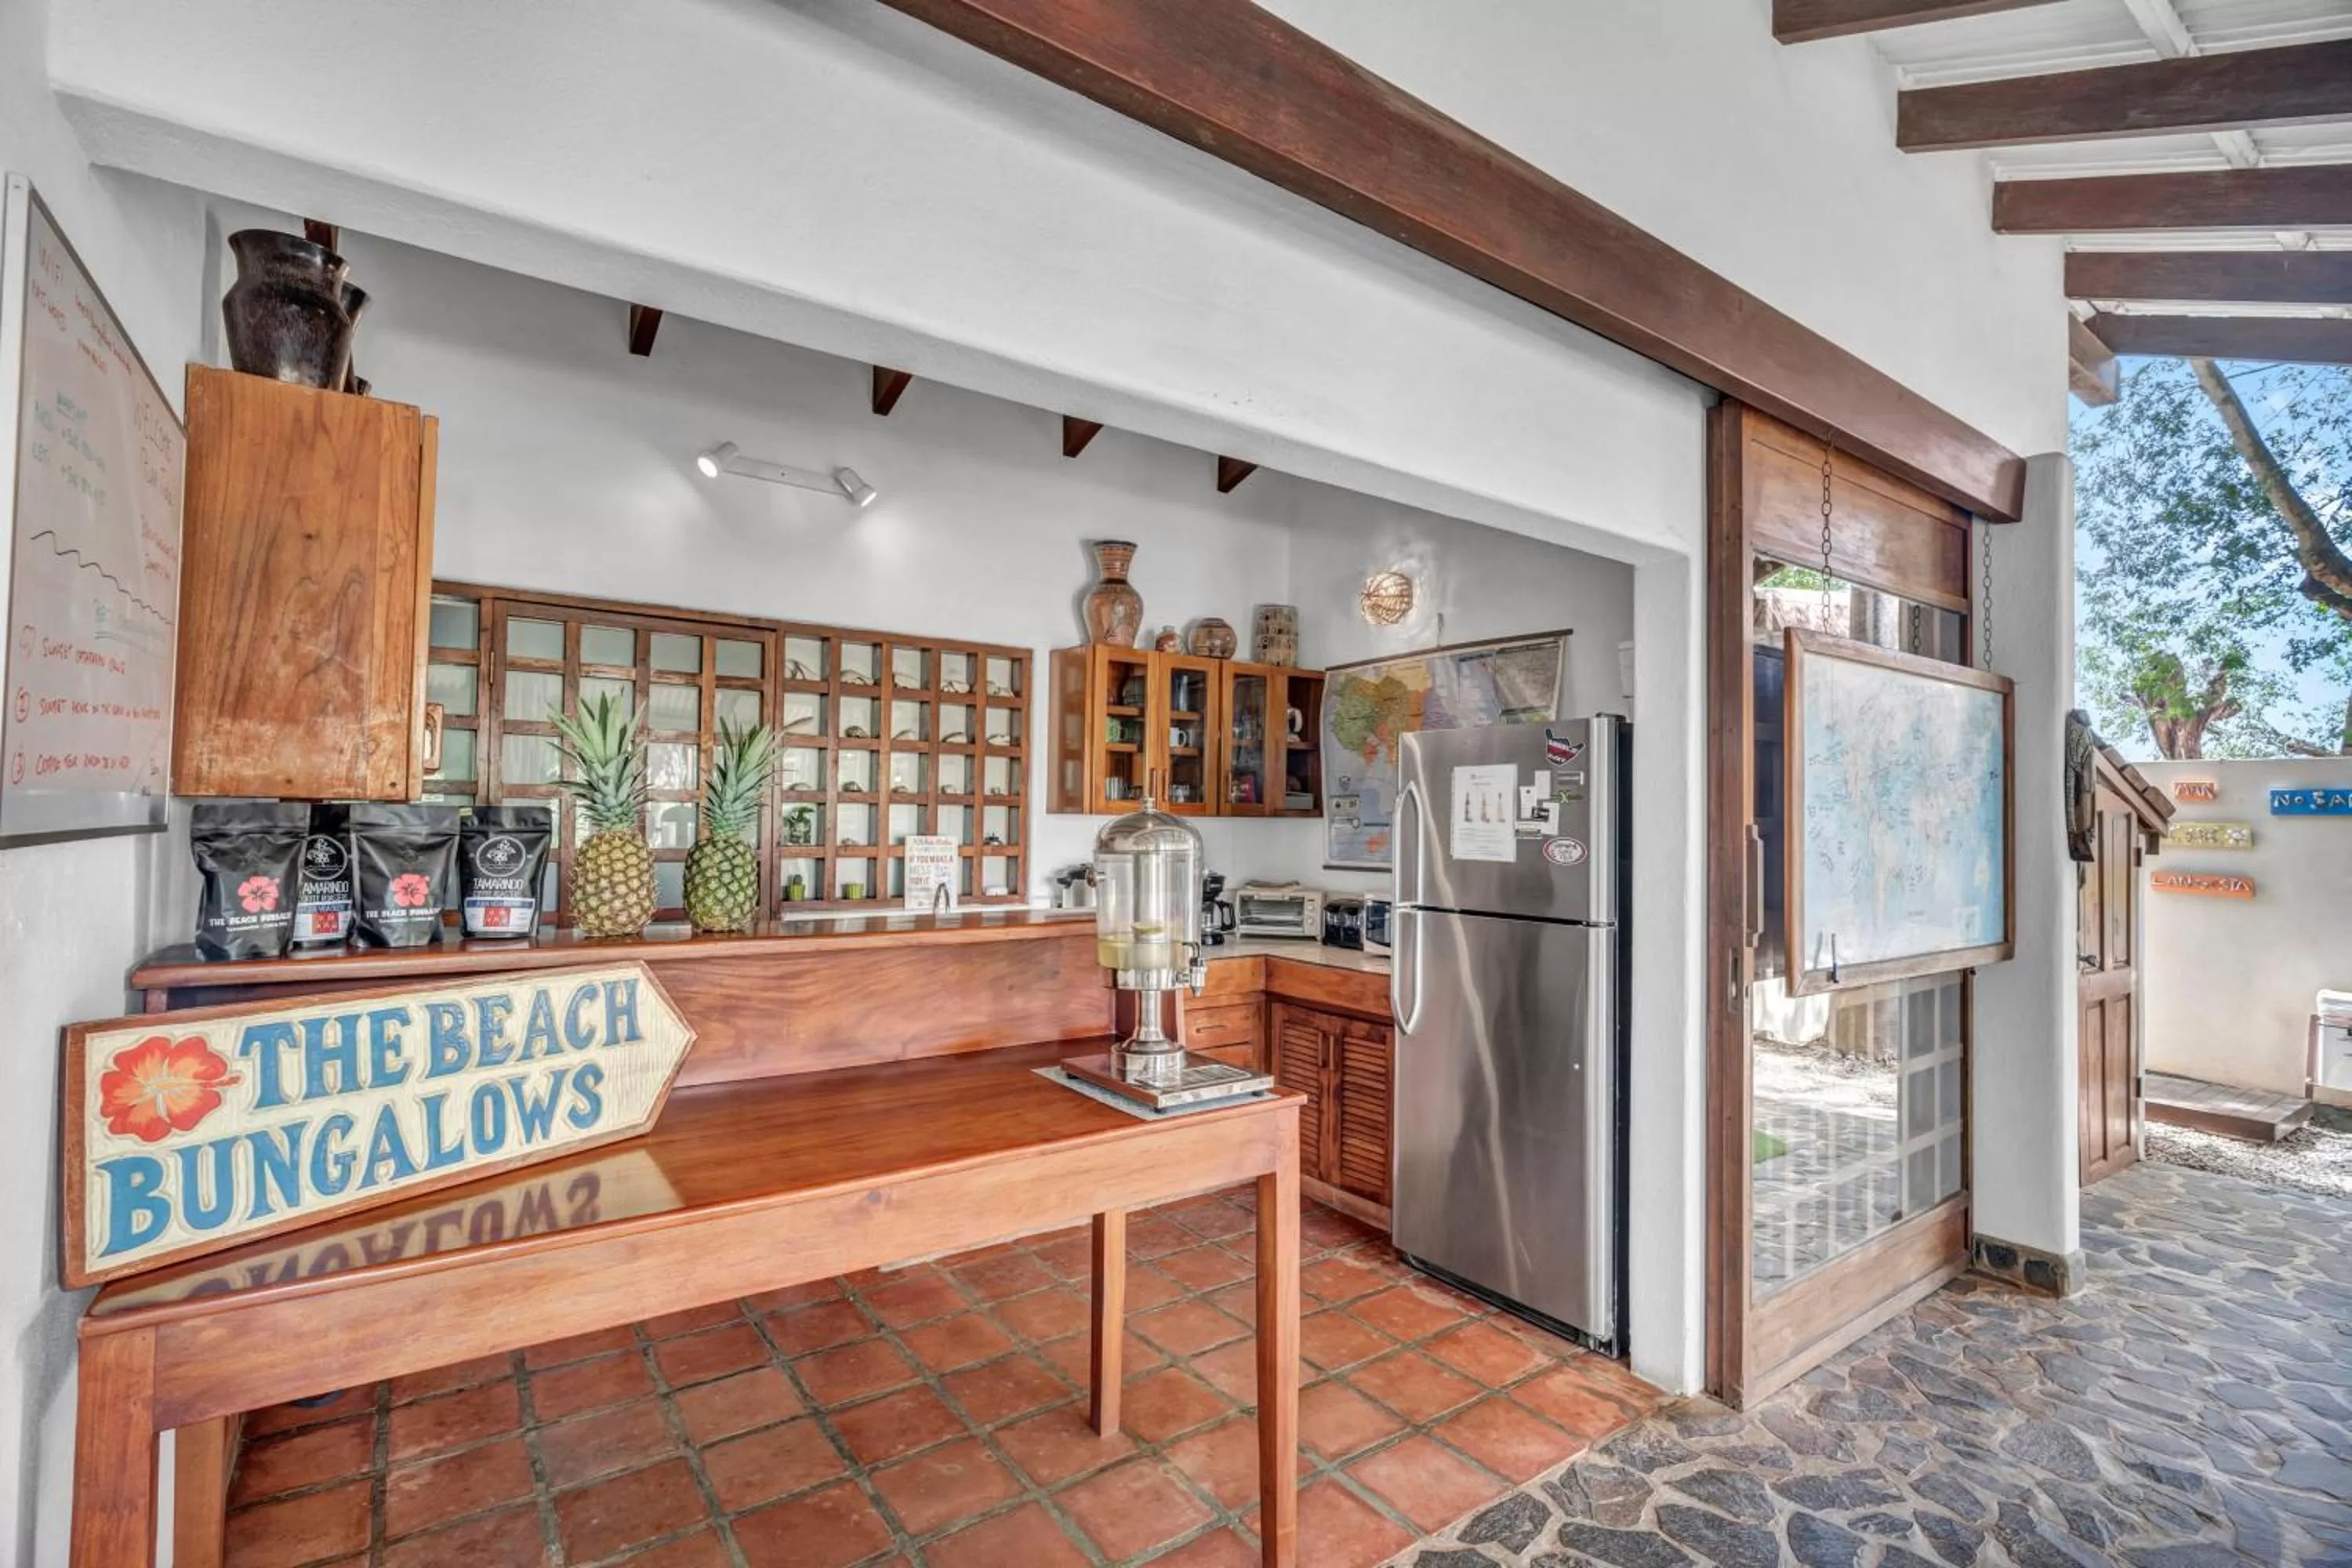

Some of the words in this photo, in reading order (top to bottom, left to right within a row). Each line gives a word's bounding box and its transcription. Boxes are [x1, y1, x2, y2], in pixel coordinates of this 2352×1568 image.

[239, 1007, 412, 1110] THE
[423, 978, 643, 1078] BEACH
[96, 1065, 604, 1258] BUNGALOWS
